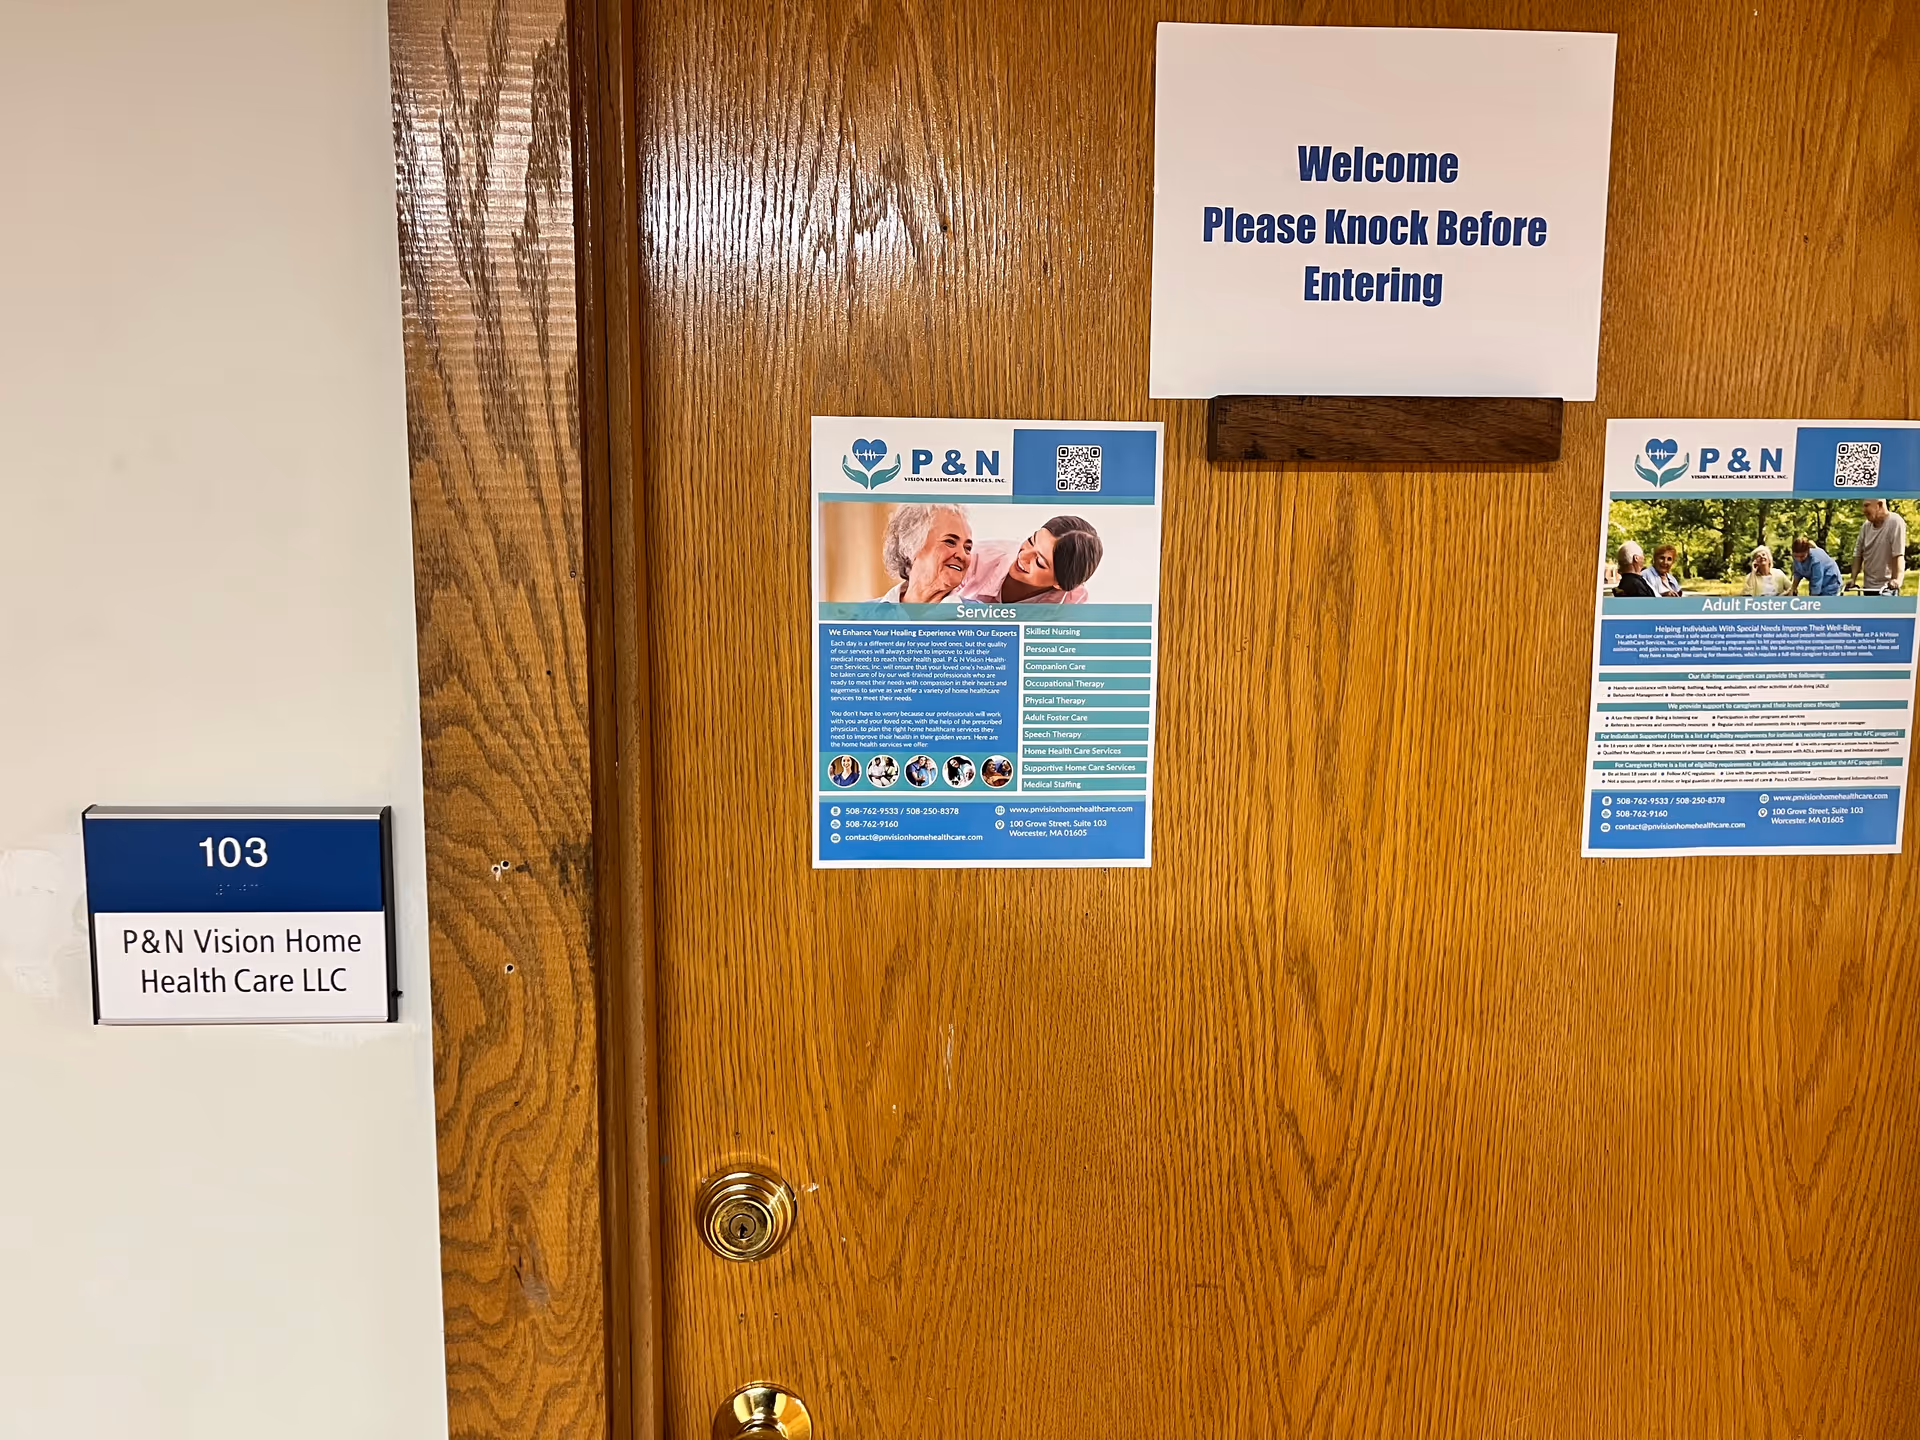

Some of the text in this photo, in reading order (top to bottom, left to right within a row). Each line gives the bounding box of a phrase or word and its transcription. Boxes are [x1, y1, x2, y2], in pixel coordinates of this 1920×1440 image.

[1298, 145, 1459, 183] Welcome
[1203, 206, 1547, 247] Please Knock Before
[1303, 266, 1443, 307] Entering
[912, 449, 999, 475] P & N
[1699, 448, 1783, 472] P & N
[1702, 598, 1821, 611] Adult Foster Care
[956, 605, 1017, 618] Services
[890, 629, 916, 637] Healing
[918, 629, 956, 638] Experience
[990, 630, 1017, 638] Experts
[1051, 628, 1081, 637] Nursing
[1655, 626, 1681, 634] Helping
[1736, 625, 1759, 633] Special
[1781, 625, 1808, 633] Improve
[1826, 625, 1861, 633] Well-Being
[845, 640, 857, 648] day
[894, 640, 906, 648] day
[1025, 663, 1067, 671] Companion
[1766, 672, 1787, 680] provide
[1025, 680, 1105, 688] Occupational Therapy
[1025, 697, 1086, 705] Physical Therapy
[1732, 702, 1760, 710] caregivers
[1024, 731, 1082, 739] Speech Therapy
[1024, 747, 1046, 755] Home
[1047, 747, 1072, 755] Health
[1024, 764, 1063, 773] Supportive
[1024, 780, 1081, 789] Medical Staffing
[1616, 797, 1668, 805] 508-762-9533
[1669, 797, 1674, 805] /
[1773, 793, 1888, 802] www.pnvisionhomehealthcare.com
[845, 807, 959, 815] 508-762-9533 / 508-250-8378
[1009, 805, 1133, 814] www.pnvisionhomehealthcare.com
[1808, 807, 1830, 815] Street,
[845, 820, 898, 828] 508-762-9160
[1048, 820, 1071, 828] Street,
[1771, 817, 1807, 825] Worcester,
[1615, 821, 1745, 832] contact@pnvisionhomehealthcare.com
[845, 834, 983, 842] contact@pnvisionhomehealthcare.com
[1009, 830, 1048, 838] Worcester,
[199, 837, 268, 868] 103
[123, 929, 361, 954] P&N Vision Home
[141, 968, 347, 993] Health Care LLC
